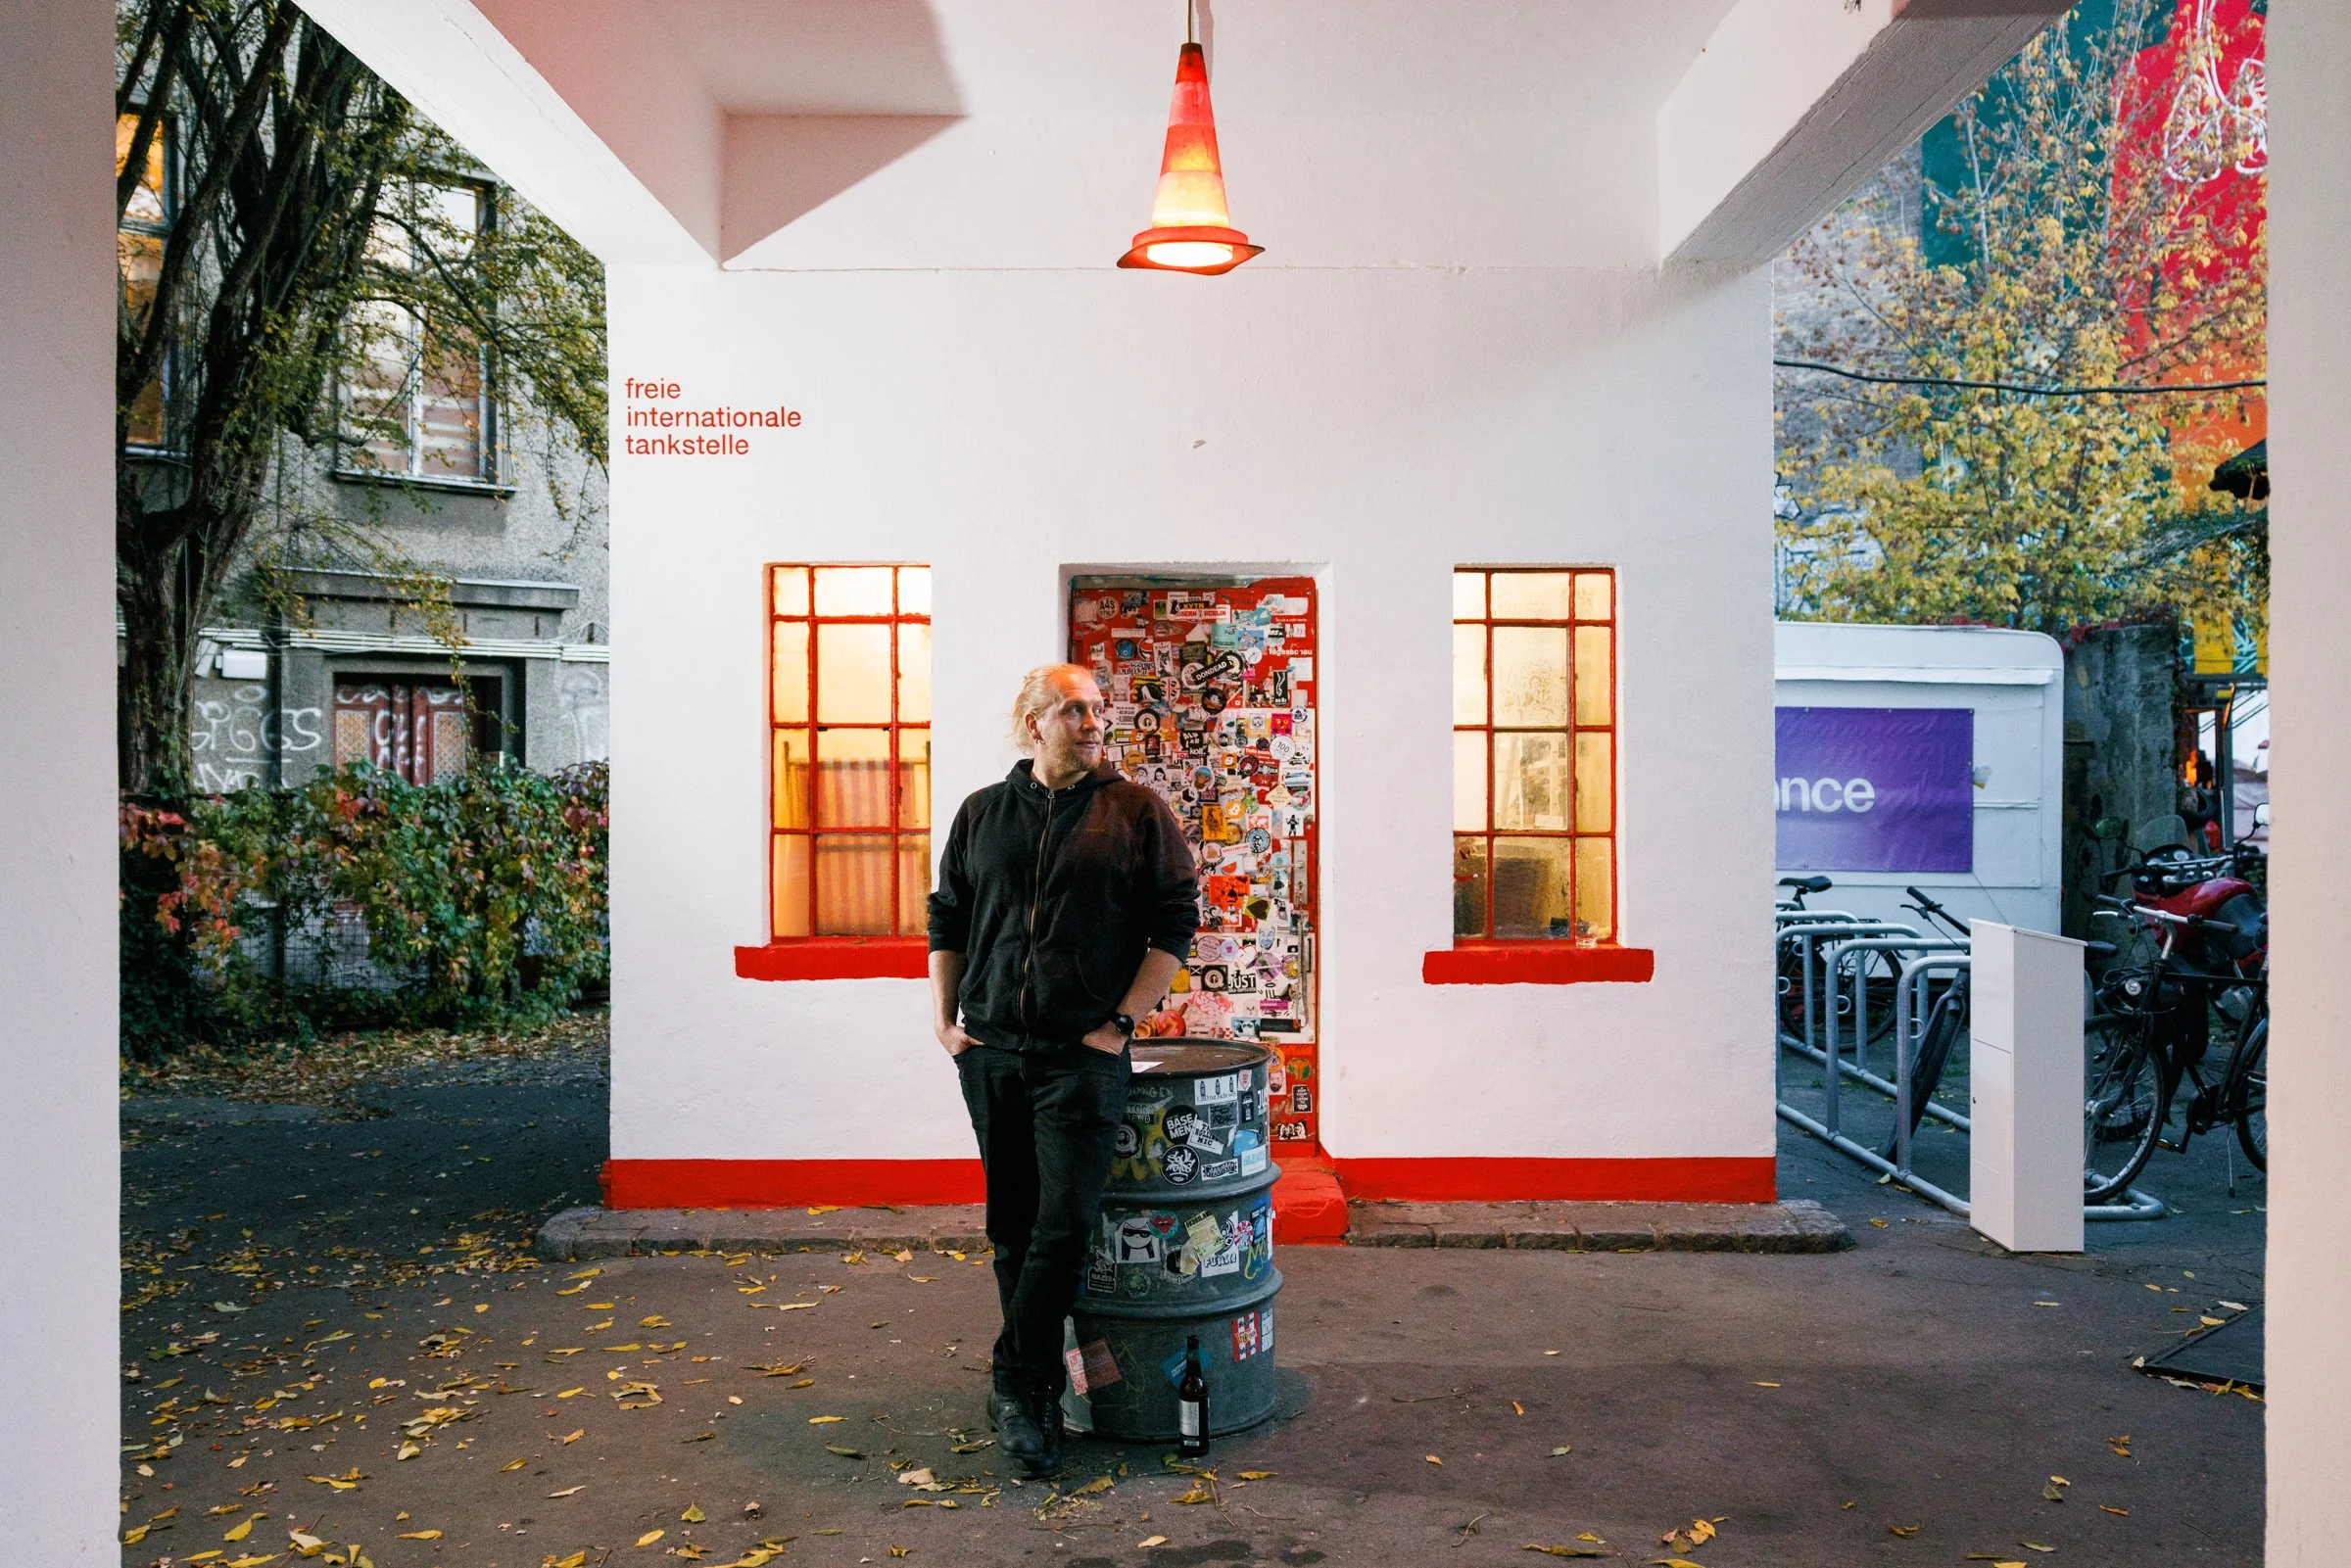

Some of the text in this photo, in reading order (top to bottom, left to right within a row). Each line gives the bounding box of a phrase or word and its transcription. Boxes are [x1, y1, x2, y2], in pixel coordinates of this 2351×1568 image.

[625, 378, 681, 399] freie
[627, 405, 801, 428] internationale
[625, 434, 749, 455] tankstelle
[1277, 741, 1290, 753] 100
[1227, 974, 1256, 989] JUST
[1166, 1114, 1193, 1130] BASE
[1196, 1137, 1214, 1147] MIC
